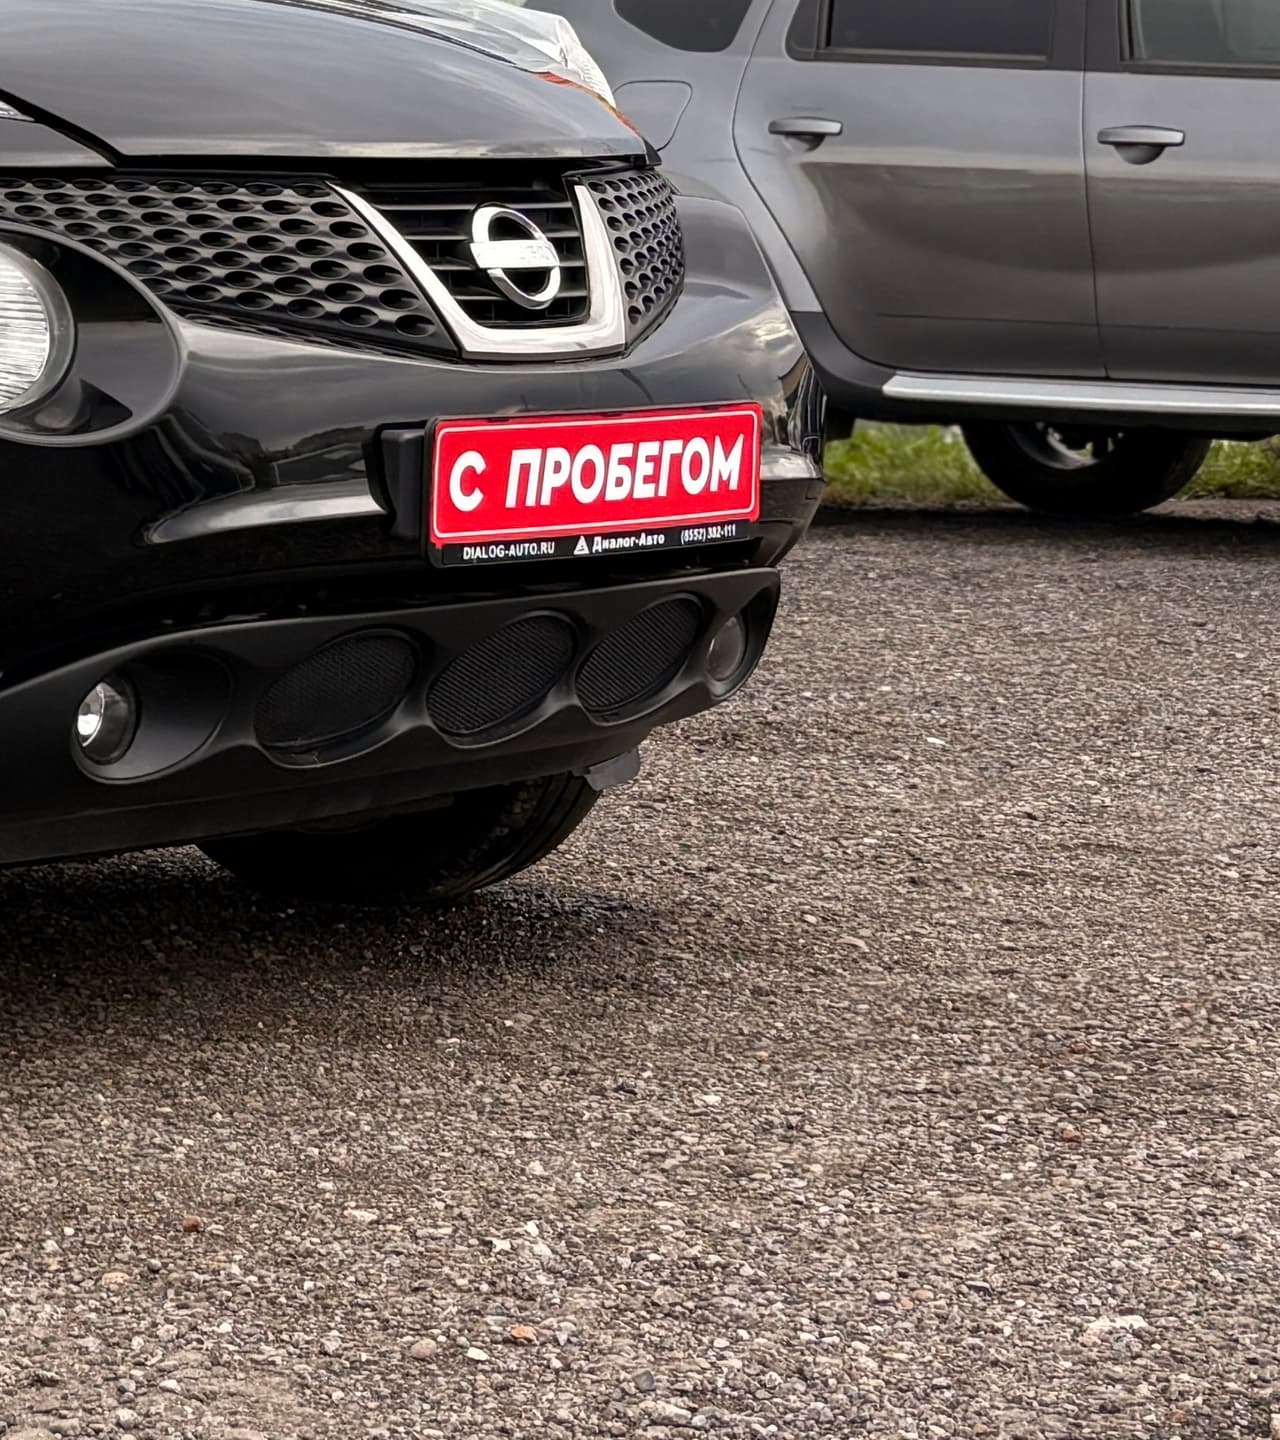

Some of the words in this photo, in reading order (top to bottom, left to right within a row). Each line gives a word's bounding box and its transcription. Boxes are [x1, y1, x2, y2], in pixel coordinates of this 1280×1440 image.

[449, 450, 487, 512] С
[505, 433, 745, 508] ПРОБЕГОМ
[463, 541, 555, 560] DIALOG-AUTO.RU
